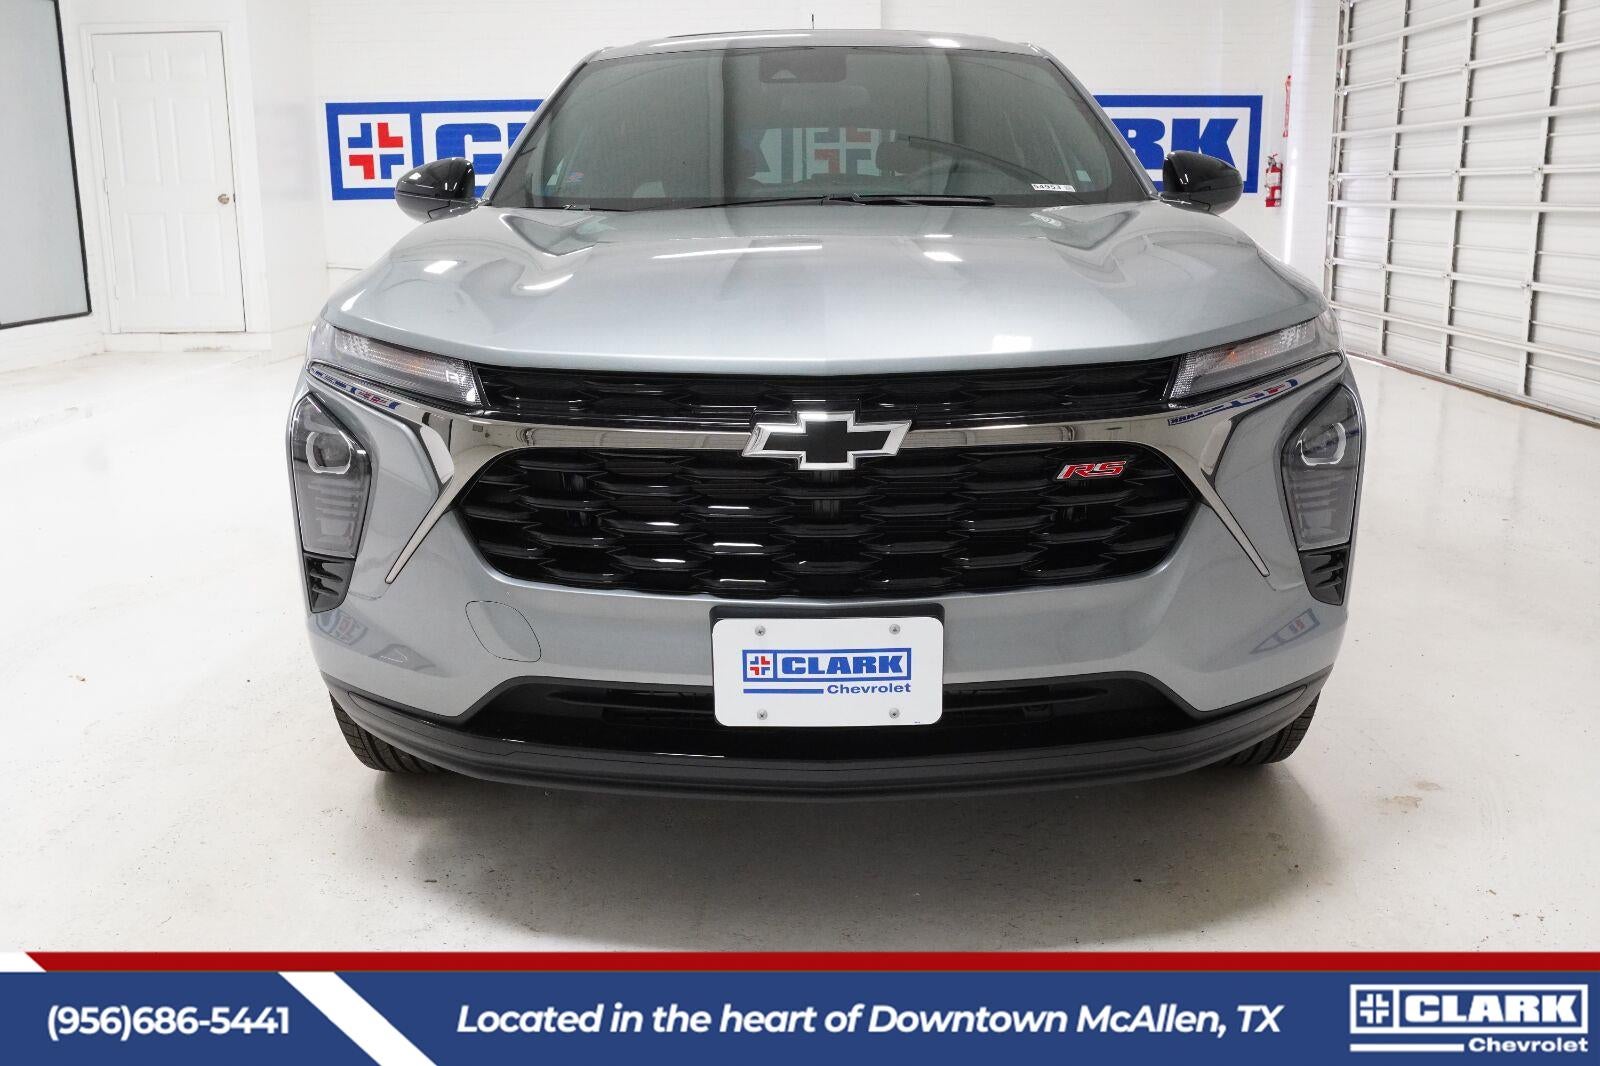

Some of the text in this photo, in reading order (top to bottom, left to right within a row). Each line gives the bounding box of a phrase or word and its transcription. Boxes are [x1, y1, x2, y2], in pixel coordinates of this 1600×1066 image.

[1056, 460, 1127, 479] RS
[781, 655, 903, 675] CLARK
[827, 682, 912, 695] Chevrolet
